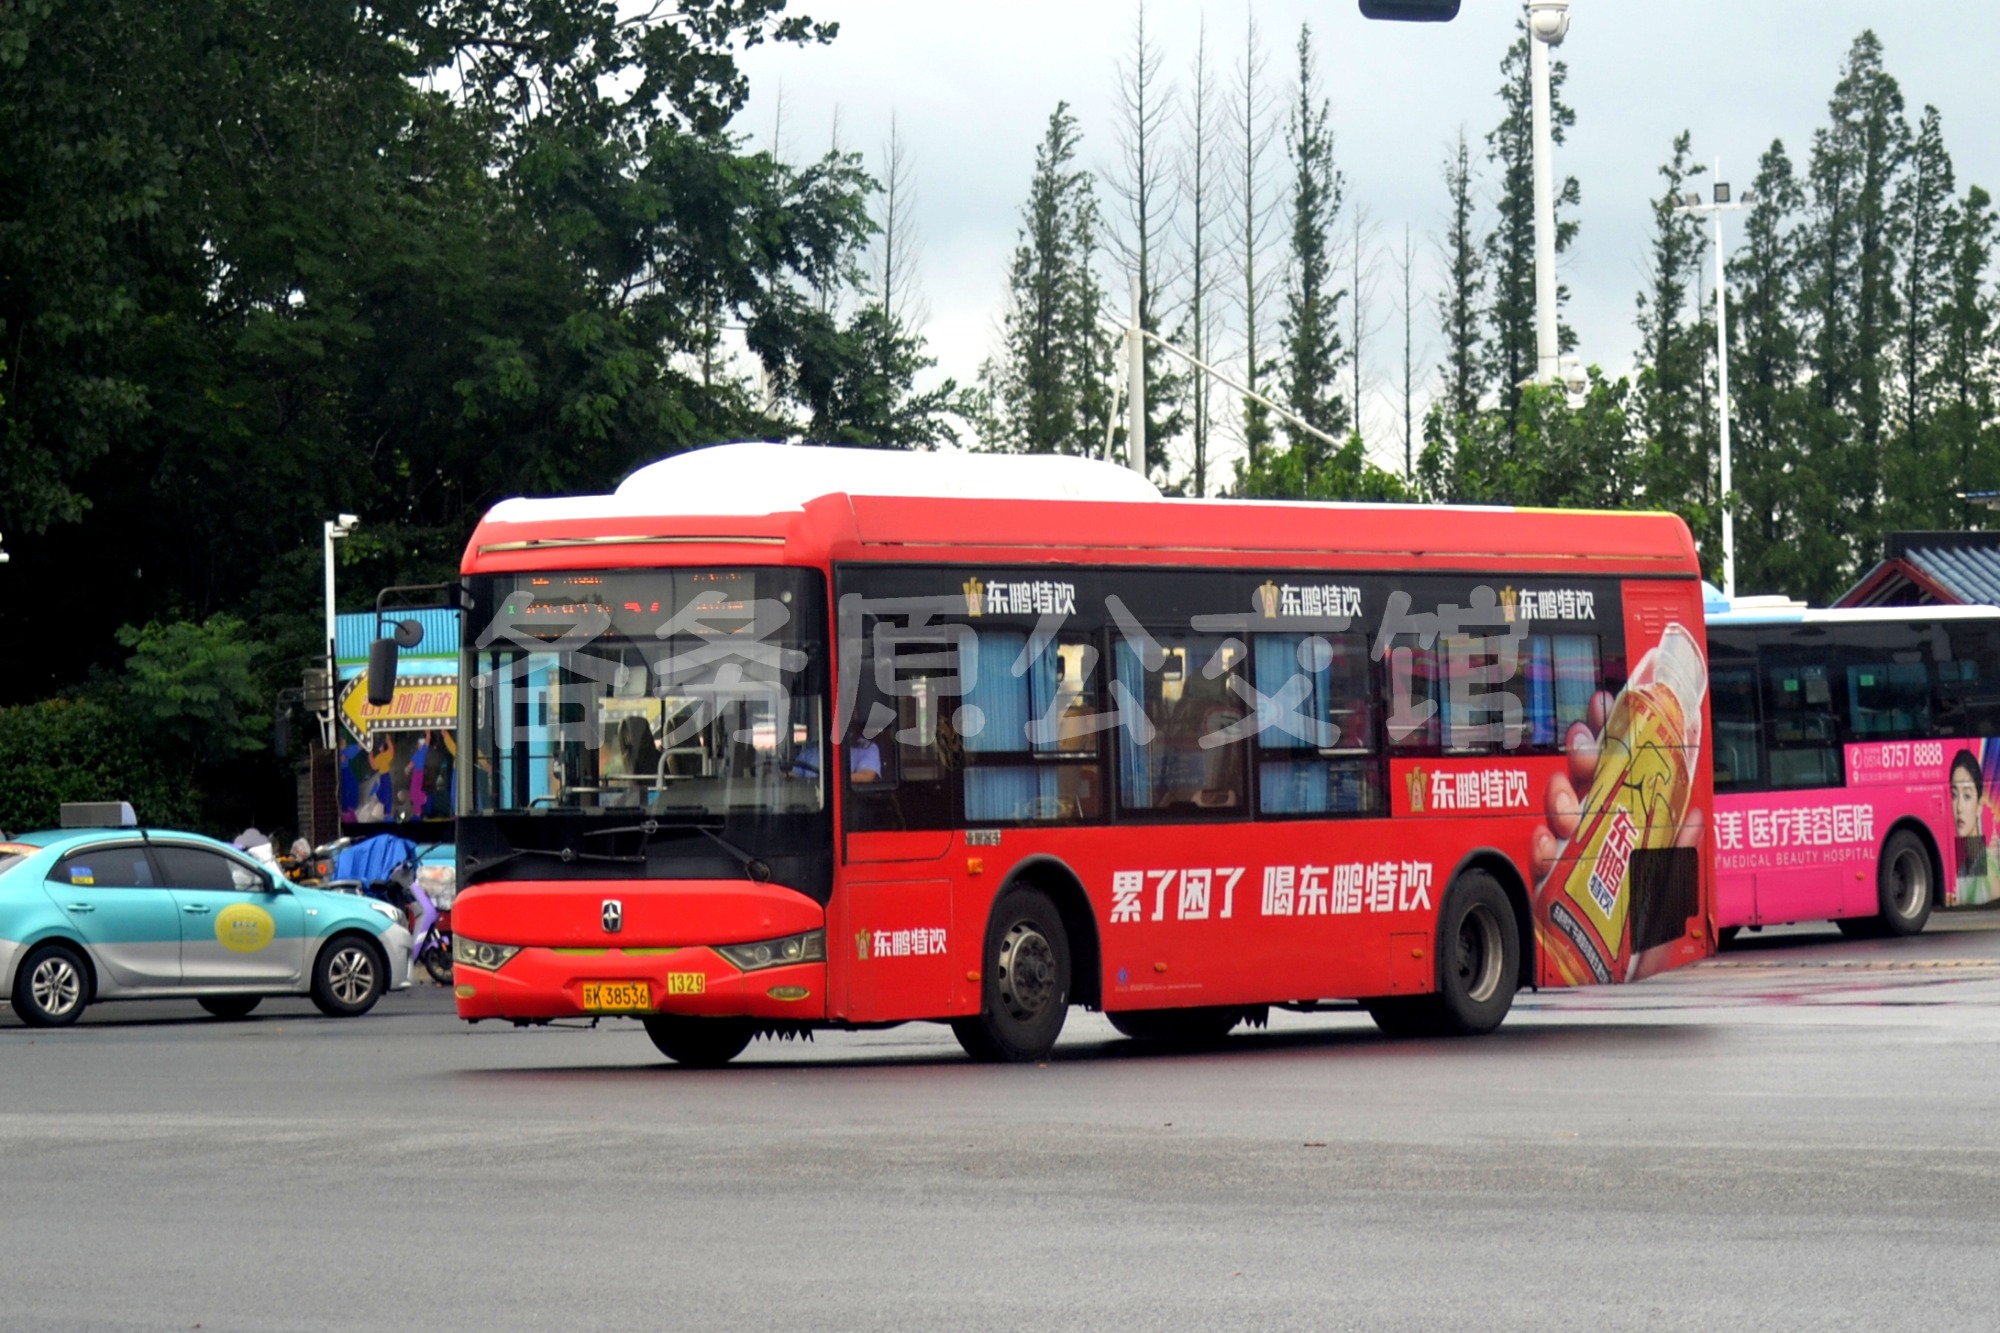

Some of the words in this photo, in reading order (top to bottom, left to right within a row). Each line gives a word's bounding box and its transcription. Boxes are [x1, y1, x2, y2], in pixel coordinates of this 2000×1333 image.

[986, 581, 1077, 615] 东鹏特饮
[1280, 584, 1363, 617] 东鹏特饮
[1518, 588, 1595, 620] 东鹏特饮
[1882, 744, 1910, 768] 8757
[1913, 742, 1943, 766] 8888
[1431, 770, 1529, 809] 东鹏特饮
[1748, 803, 1875, 848] 医疗美容医院
[1722, 855, 1771, 869] MEDICAL
[1776, 851, 1819, 865] BEAUTY
[1823, 847, 1875, 862] HOSPITAL
[1110, 867, 1245, 923] 累了困了
[1261, 859, 1433, 917] 喝东鹏特饮
[873, 927, 948, 958] 东鹏特饮
[670, 974, 704, 992] 1329
